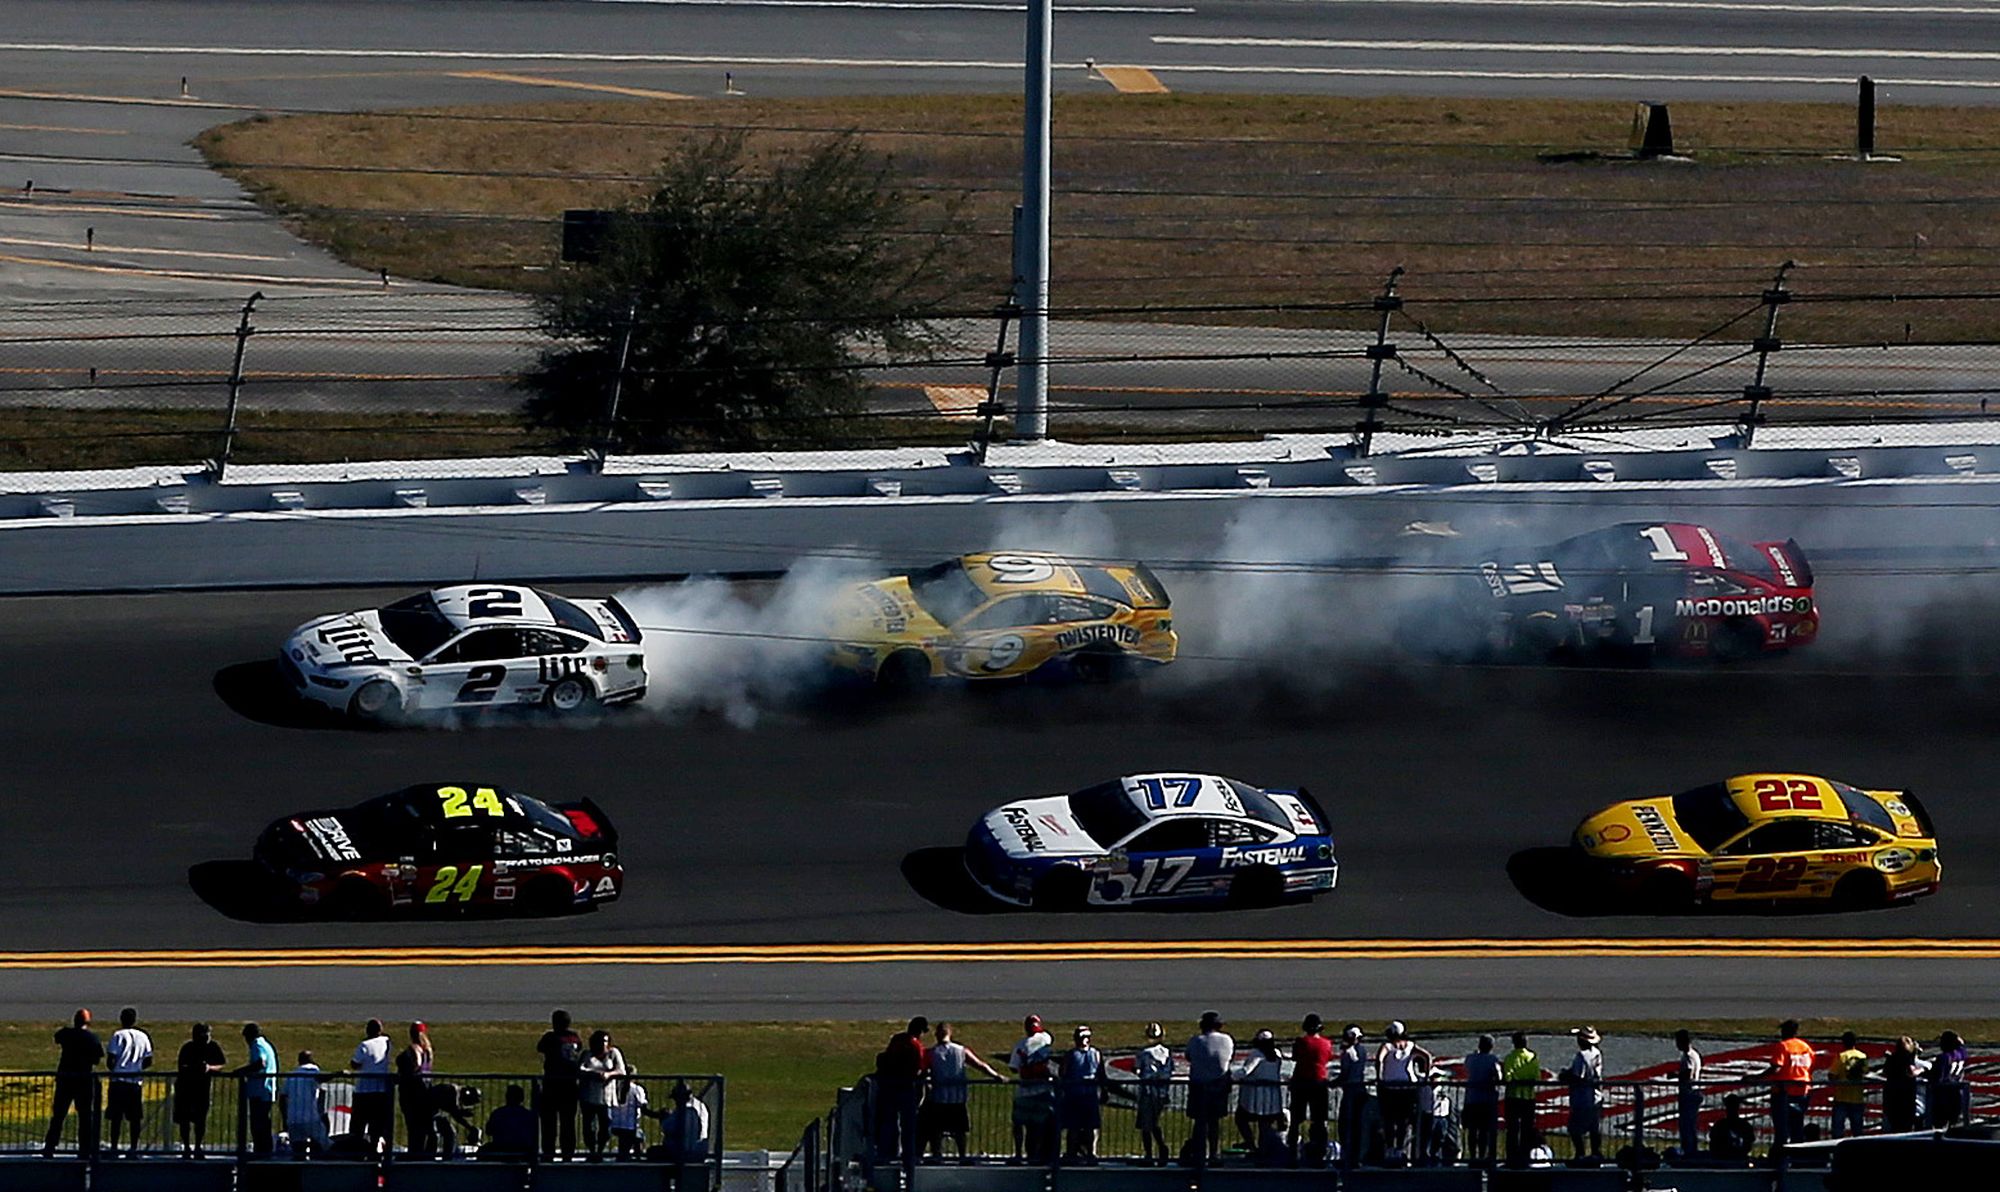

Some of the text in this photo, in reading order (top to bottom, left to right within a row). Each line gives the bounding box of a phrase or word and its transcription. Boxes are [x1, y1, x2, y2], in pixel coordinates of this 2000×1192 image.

[1640, 526, 1690, 561] 1
[987, 555, 1054, 583] 9
[468, 588, 523, 619] 2
[1675, 596, 1794, 617] McDonald's
[1055, 624, 1118, 649] TWISTED
[1634, 606, 1655, 644] 1
[981, 634, 1025, 671] 9
[454, 664, 508, 702] 2
[437, 786, 504, 818] 24
[1136, 777, 1202, 811] 17
[1753, 779, 1822, 812] 22
[312, 816, 362, 860] DRIVE
[1001, 807, 1046, 853] FASTENAL
[1631, 806, 1679, 852] PENNZOIL
[1220, 845, 1307, 868] FASTENAL
[424, 865, 484, 903] 24
[1135, 856, 1197, 894] 17
[1735, 856, 1808, 894] 22
